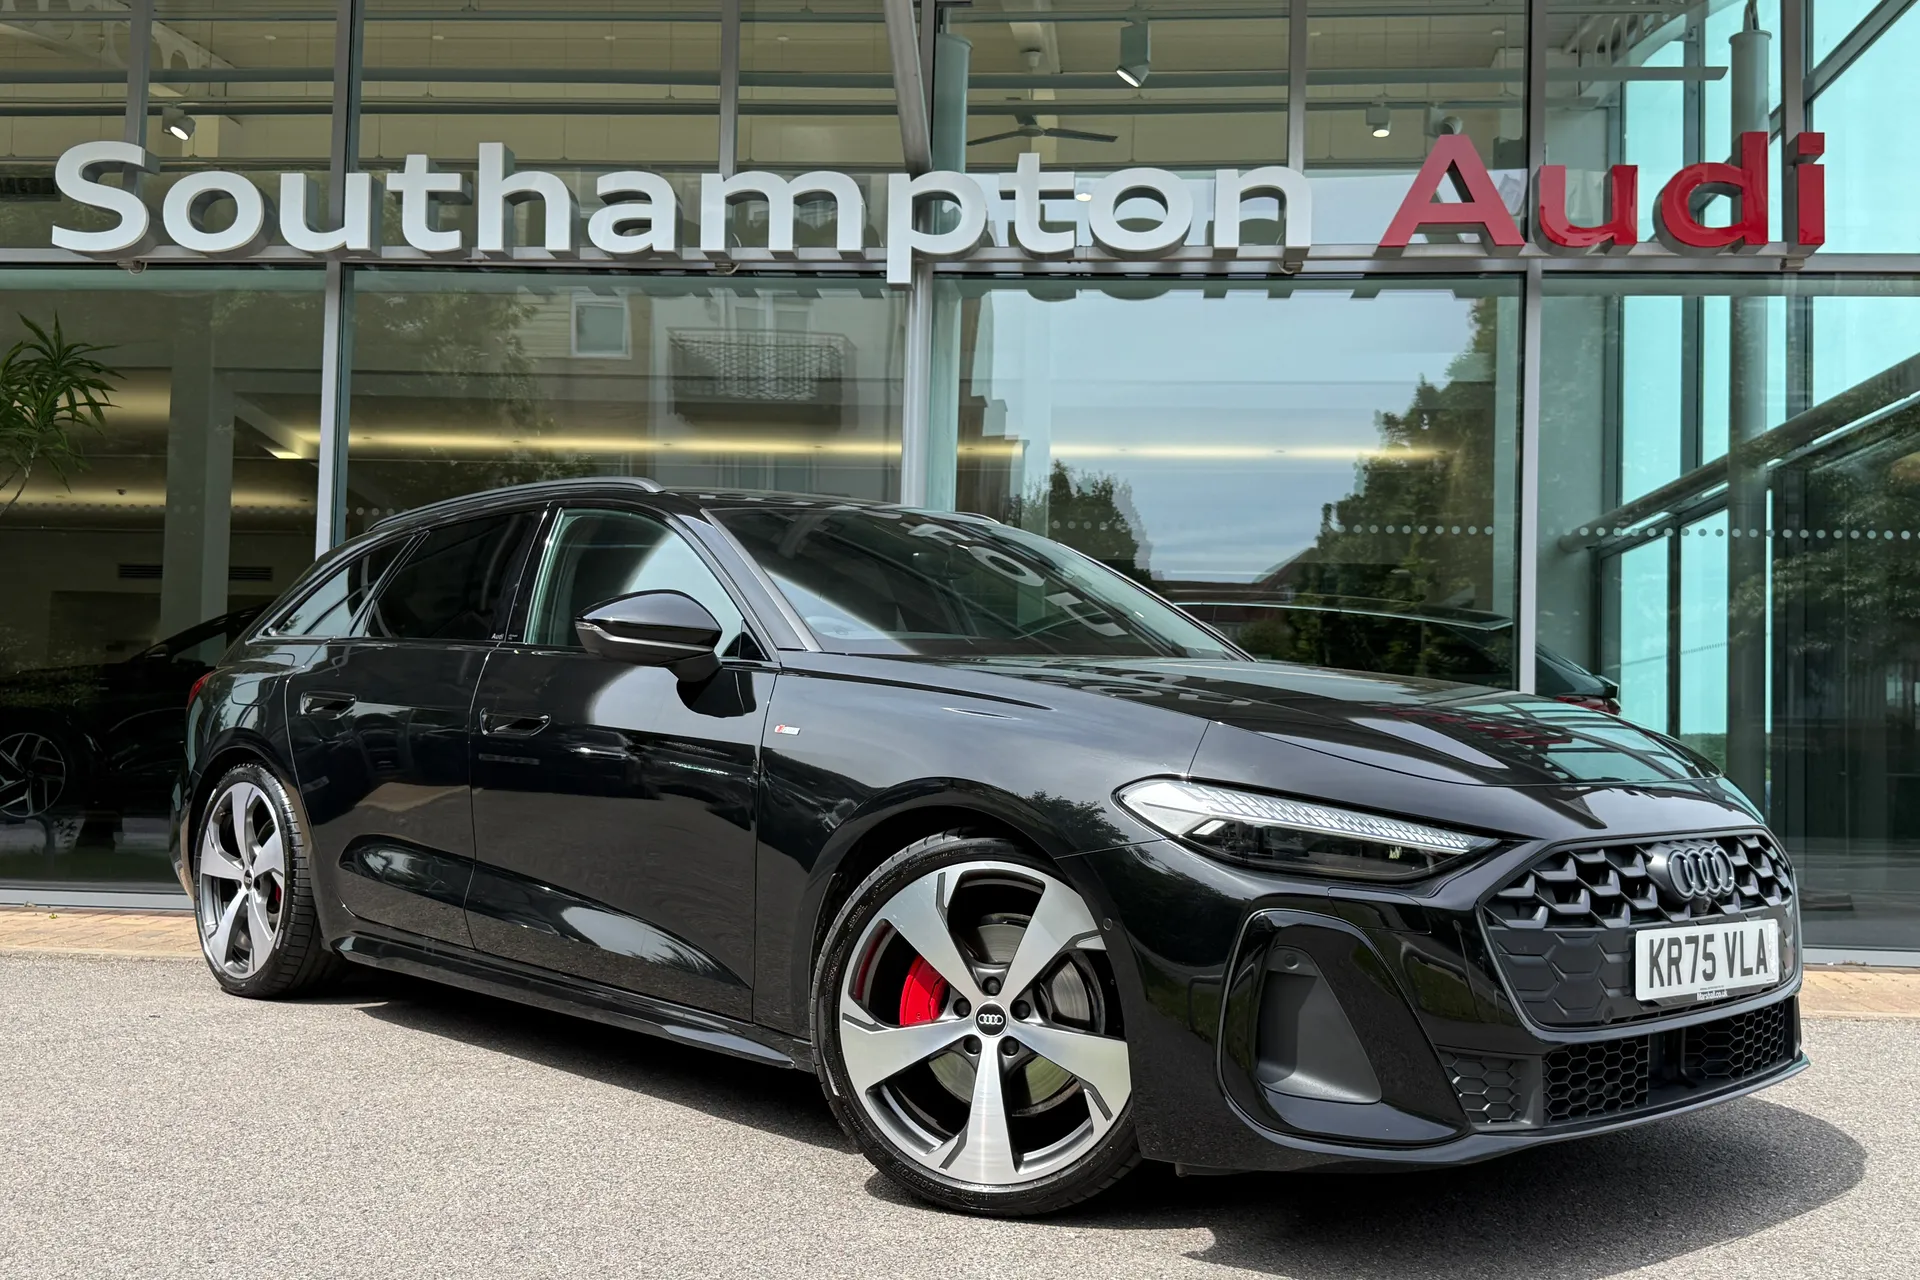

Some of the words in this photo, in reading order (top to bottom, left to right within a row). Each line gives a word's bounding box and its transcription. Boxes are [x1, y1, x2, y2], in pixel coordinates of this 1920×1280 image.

[51, 140, 1312, 284] Southampton
[1377, 131, 1826, 248] Audi
[1649, 933, 1717, 989] KR75
[1724, 928, 1768, 979] VLA
